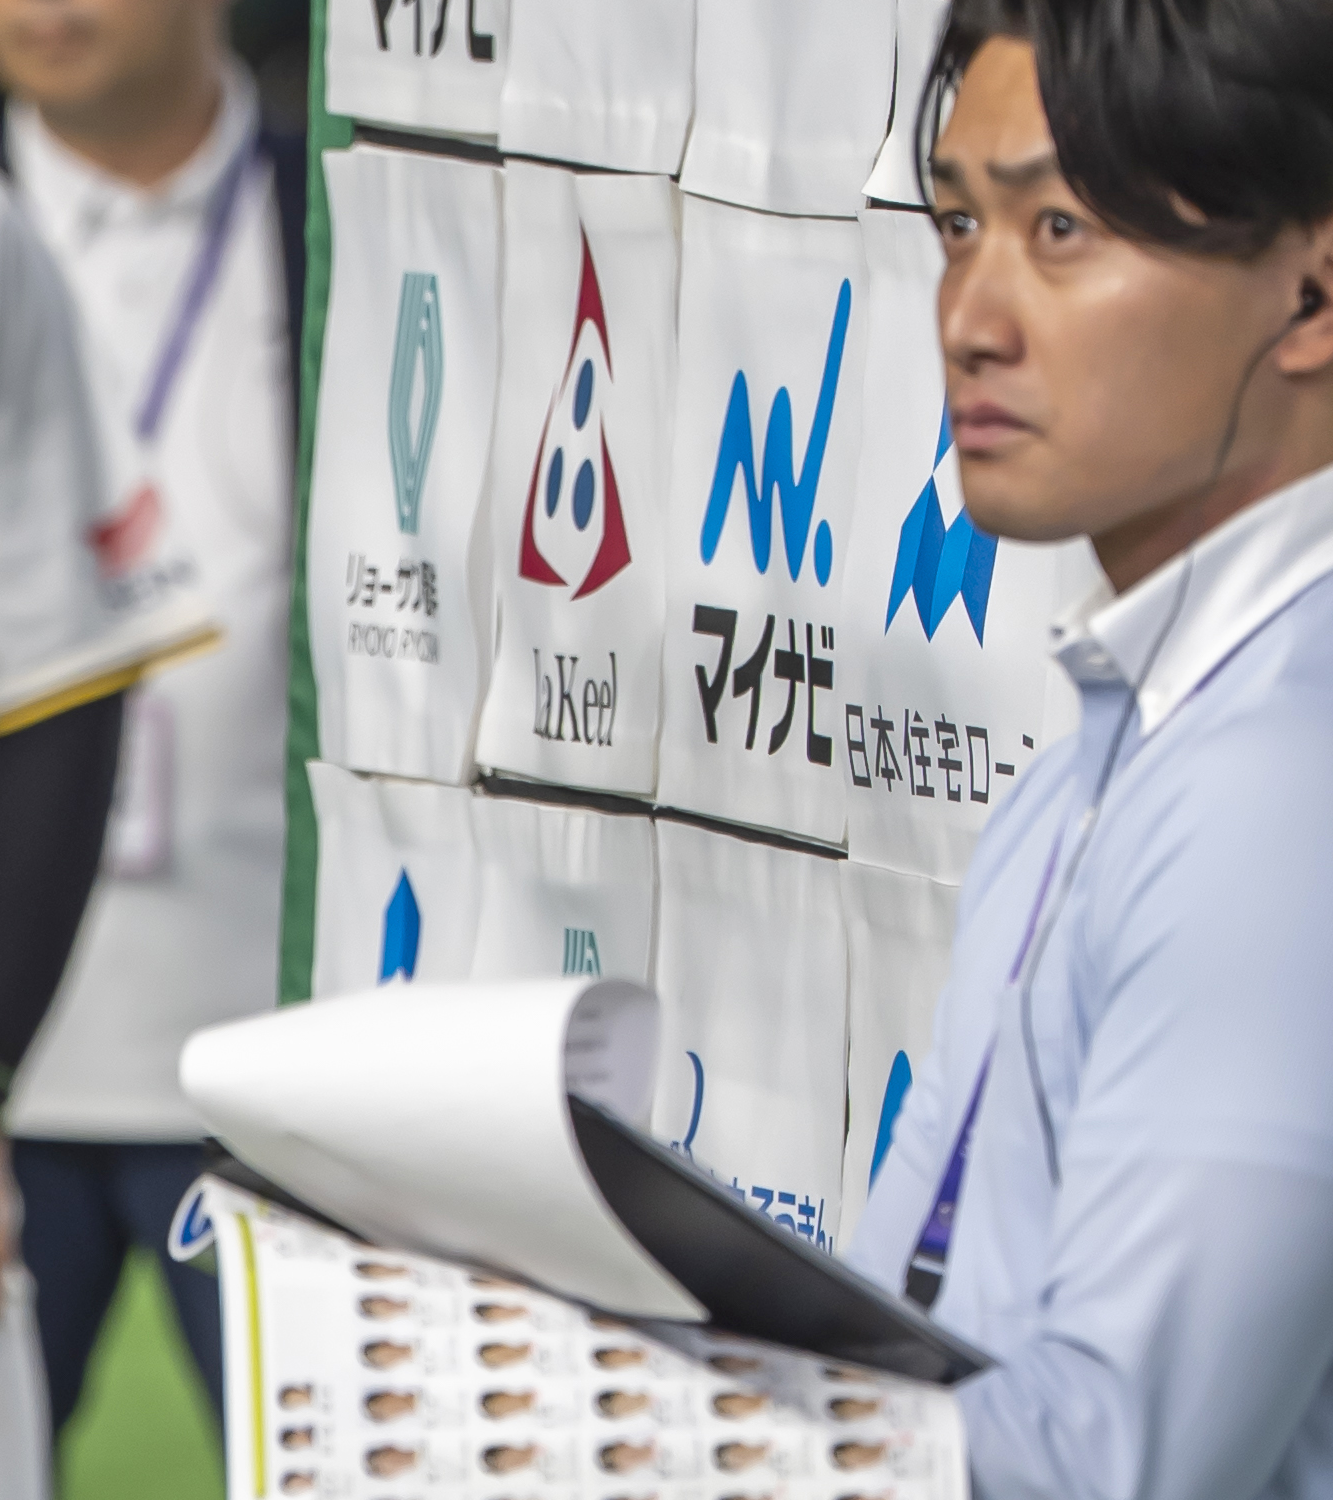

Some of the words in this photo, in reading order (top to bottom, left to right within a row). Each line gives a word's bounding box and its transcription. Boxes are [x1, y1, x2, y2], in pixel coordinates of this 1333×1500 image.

[692, 603, 834, 767] マイナビ
[845, 703, 1035, 805] 日本住宅ロー
